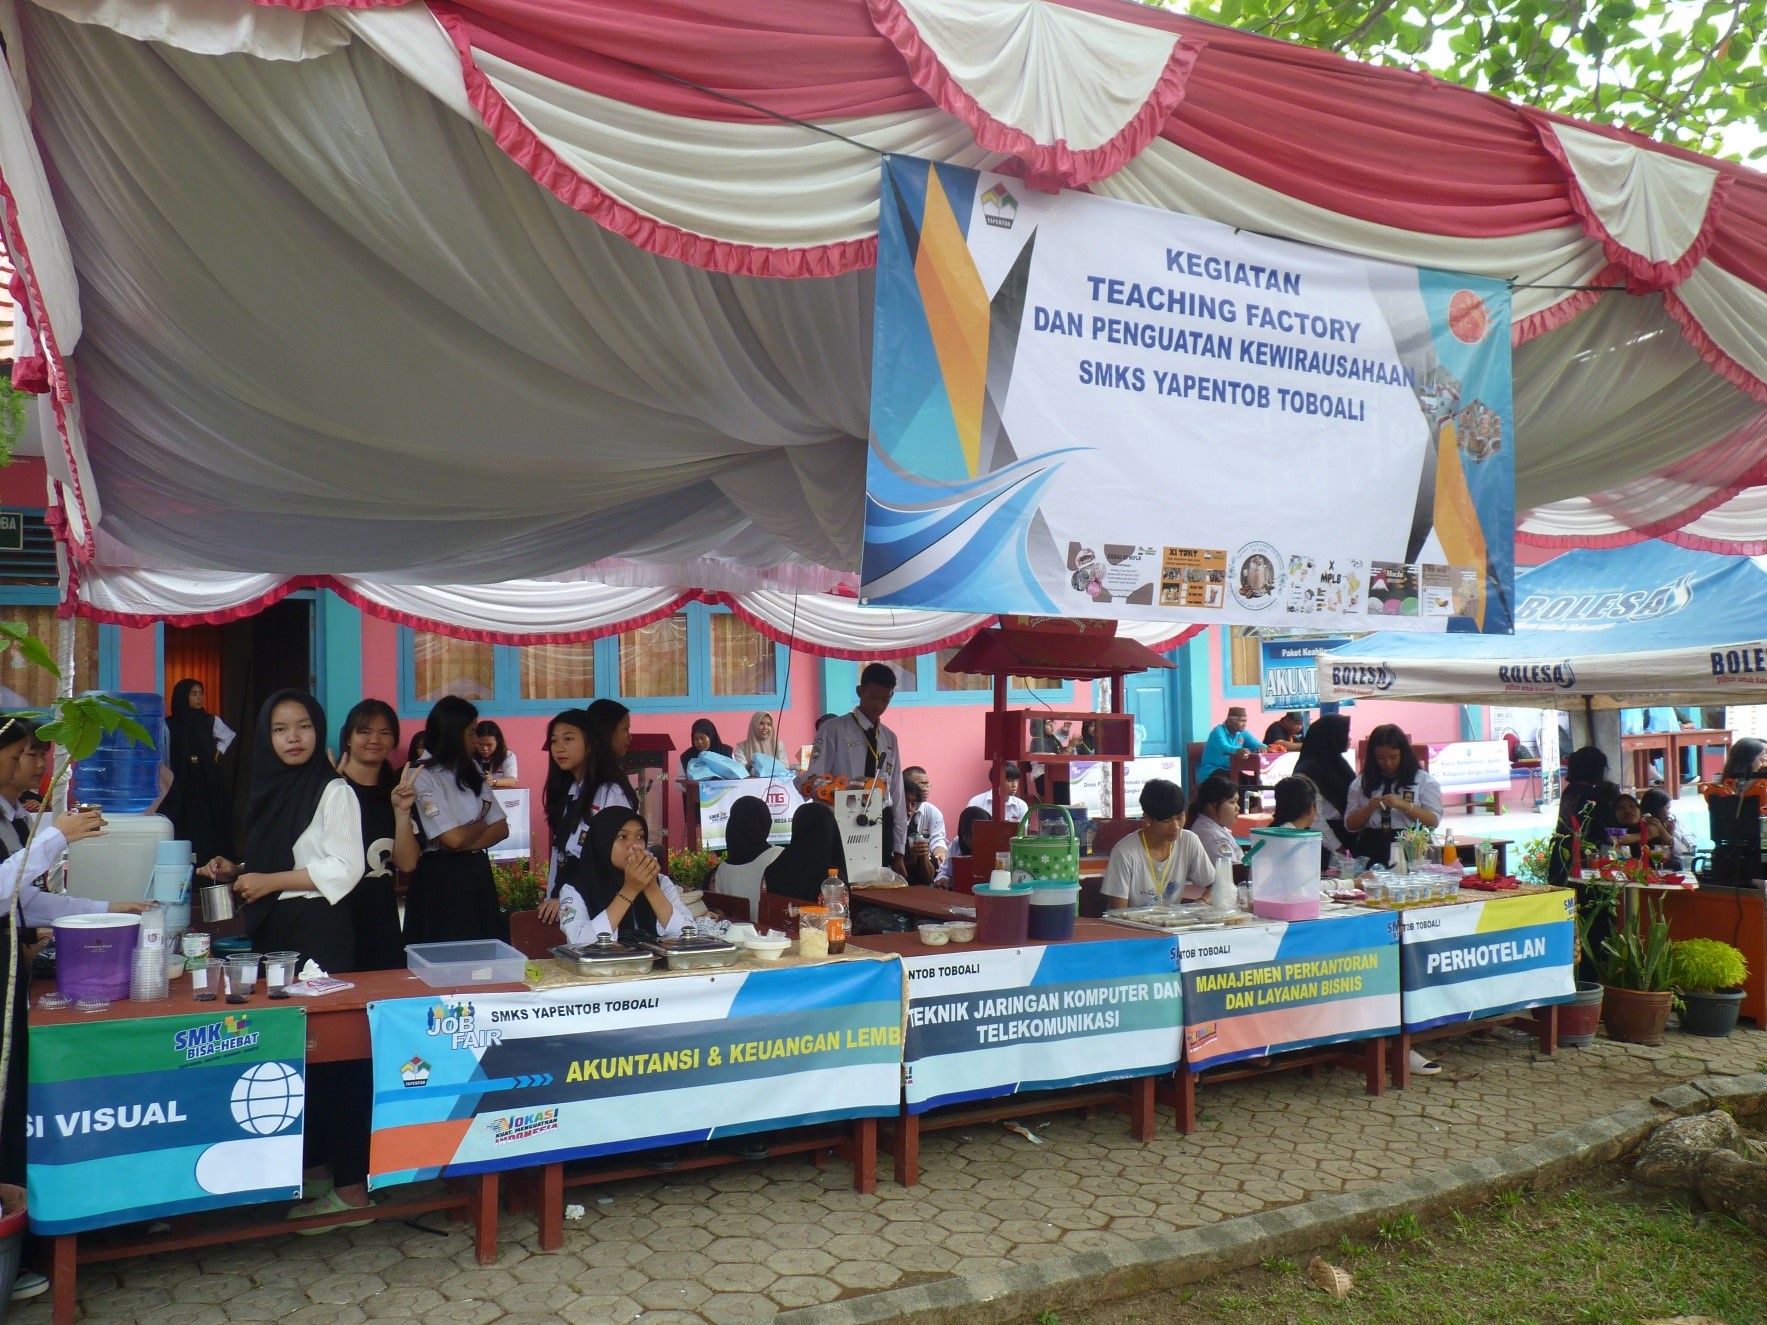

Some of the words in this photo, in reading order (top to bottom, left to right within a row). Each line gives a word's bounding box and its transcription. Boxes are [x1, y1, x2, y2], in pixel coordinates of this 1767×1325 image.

[1166, 248, 1301, 296] KEGIATAN
[1087, 275, 1236, 323] TEACHING
[1246, 304, 1361, 344] FACTORY
[1034, 306, 1083, 338] DAN
[1092, 316, 1232, 360] PENGUATAN
[1240, 340, 1415, 388] KEWIRAUSAHAAN
[1079, 359, 1146, 392] SMKS
[1153, 370, 1270, 409] YAPENTOB
[1277, 388, 1365, 421] TOBOALI
[1514, 583, 1688, 623] BOLESA
[1282, 648, 1302, 657] Paket
[1710, 647, 1767, 676] BOLE
[1332, 665, 1388, 686] BOLESA
[1498, 663, 1566, 684] BOLESA
[1416, 918, 1441, 930] TOBOALI
[1198, 944, 1231, 958] TOBOALI
[1427, 937, 1546, 974] PERHOTELAN
[938, 963, 980, 978] TOBOALI
[1196, 966, 1282, 993] MANAJEMEN
[1285, 954, 1379, 981] PERKANTORAN
[908, 1000, 969, 1028] TEKNIK
[974, 991, 1061, 1019] JARINGAN
[1063, 983, 1149, 1009] KOMPUTER
[1153, 980, 1182, 1000] DAN
[1225, 993, 1254, 1010] DAN
[1257, 984, 1318, 1006] LAYANAN
[1321, 976, 1362, 996] BISNIS
[491, 1007, 529, 1023] SMKS
[532, 1002, 601, 1019] YAPENTOB
[605, 998, 660, 1014] TOBOALI
[174, 1022, 223, 1051] SMK
[427, 1015, 475, 1037] JOB
[451, 1028, 503, 1051] FAIR
[977, 1010, 1120, 1044] TELEKOMUNIKASI
[186, 1032, 260, 1060] BISA-HEBAT
[565, 1049, 700, 1083] AKUNTANSI
[707, 1046, 723, 1067] &
[729, 1030, 840, 1064] KEUANGAN
[846, 1026, 900, 1049] LEMB
[55, 1100, 187, 1137] VISUAL
[500, 1108, 559, 1131] VOKASI
[514, 1118, 558, 1133] MENGUATKAN
[495, 1123, 559, 1145] INDONESIA
